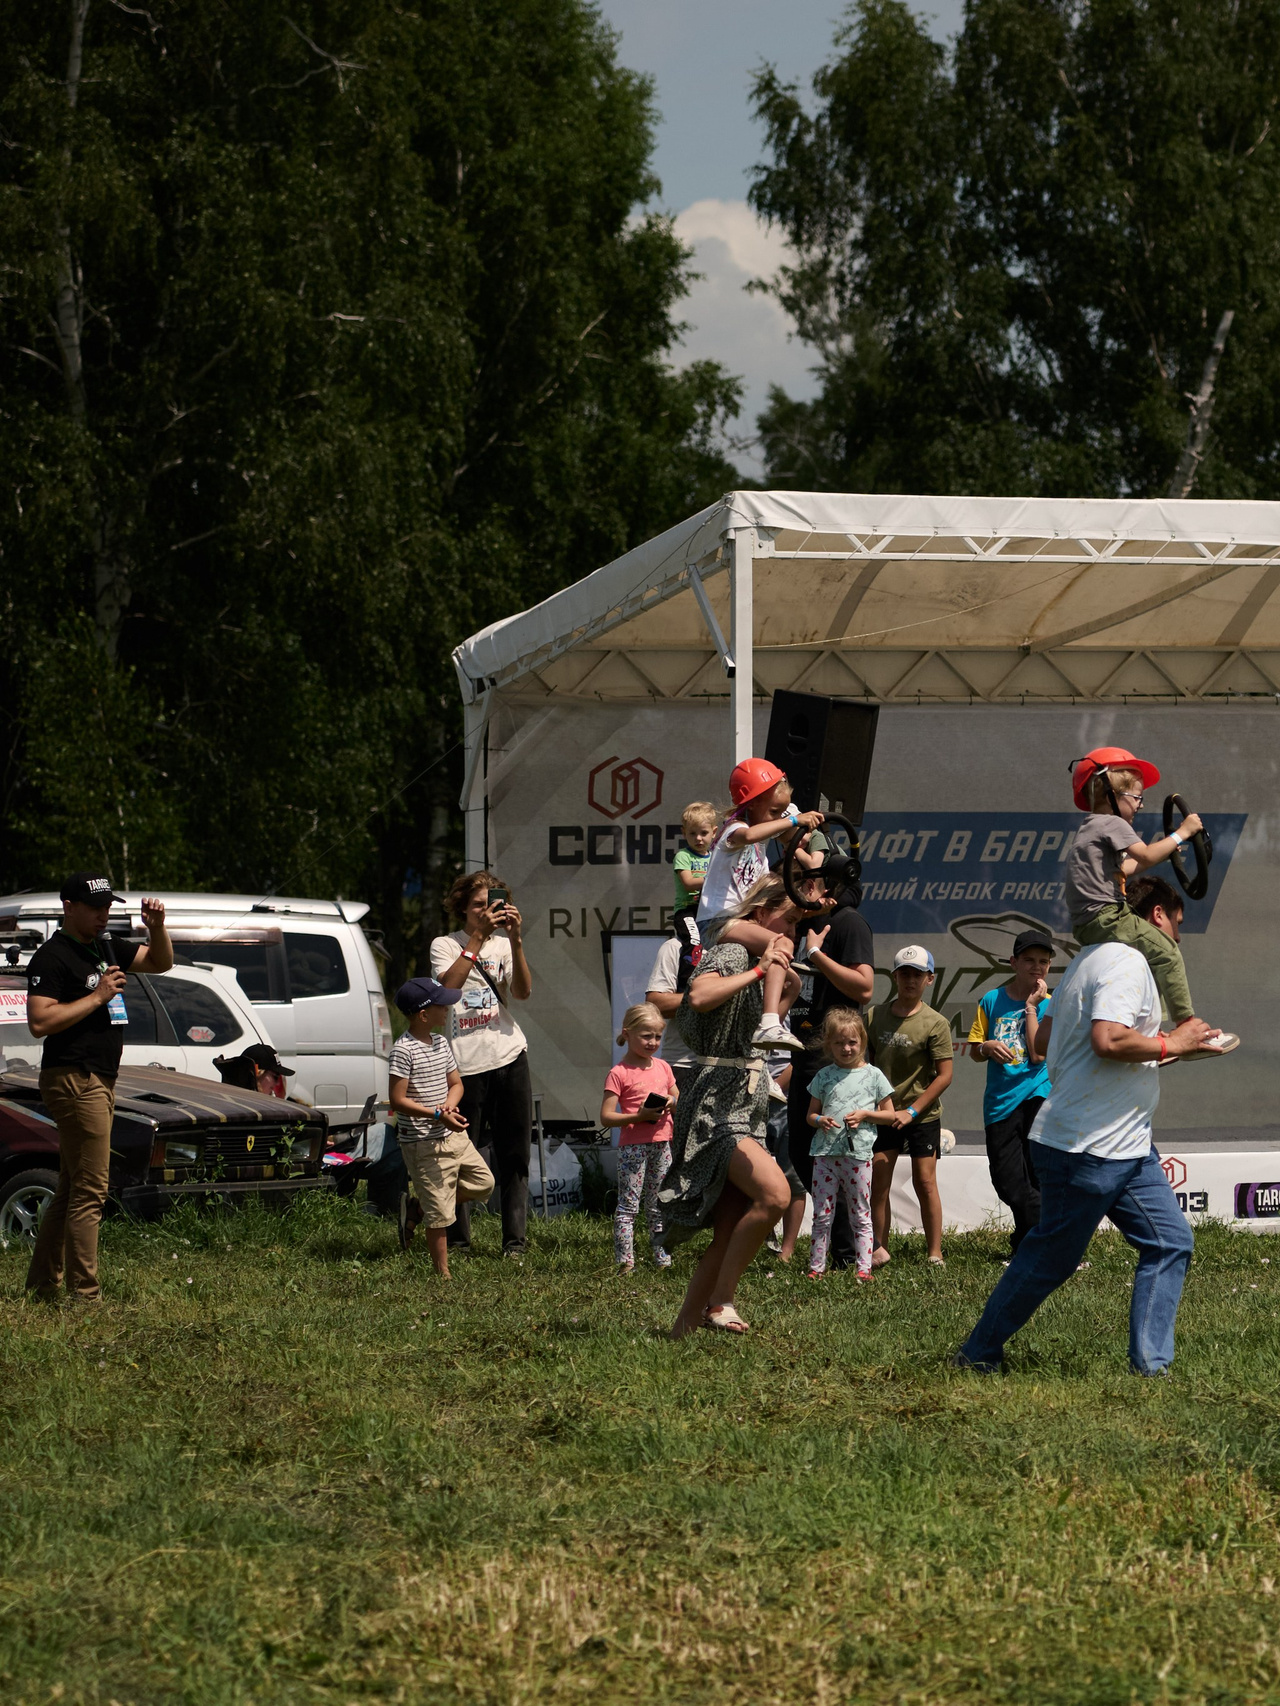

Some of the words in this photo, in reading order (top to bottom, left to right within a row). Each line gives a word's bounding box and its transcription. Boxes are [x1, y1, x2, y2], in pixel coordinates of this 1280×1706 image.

[943, 830, 973, 863] В
[921, 882, 996, 900] КУБОК
[1000, 882, 1067, 900] РАКЕТ
